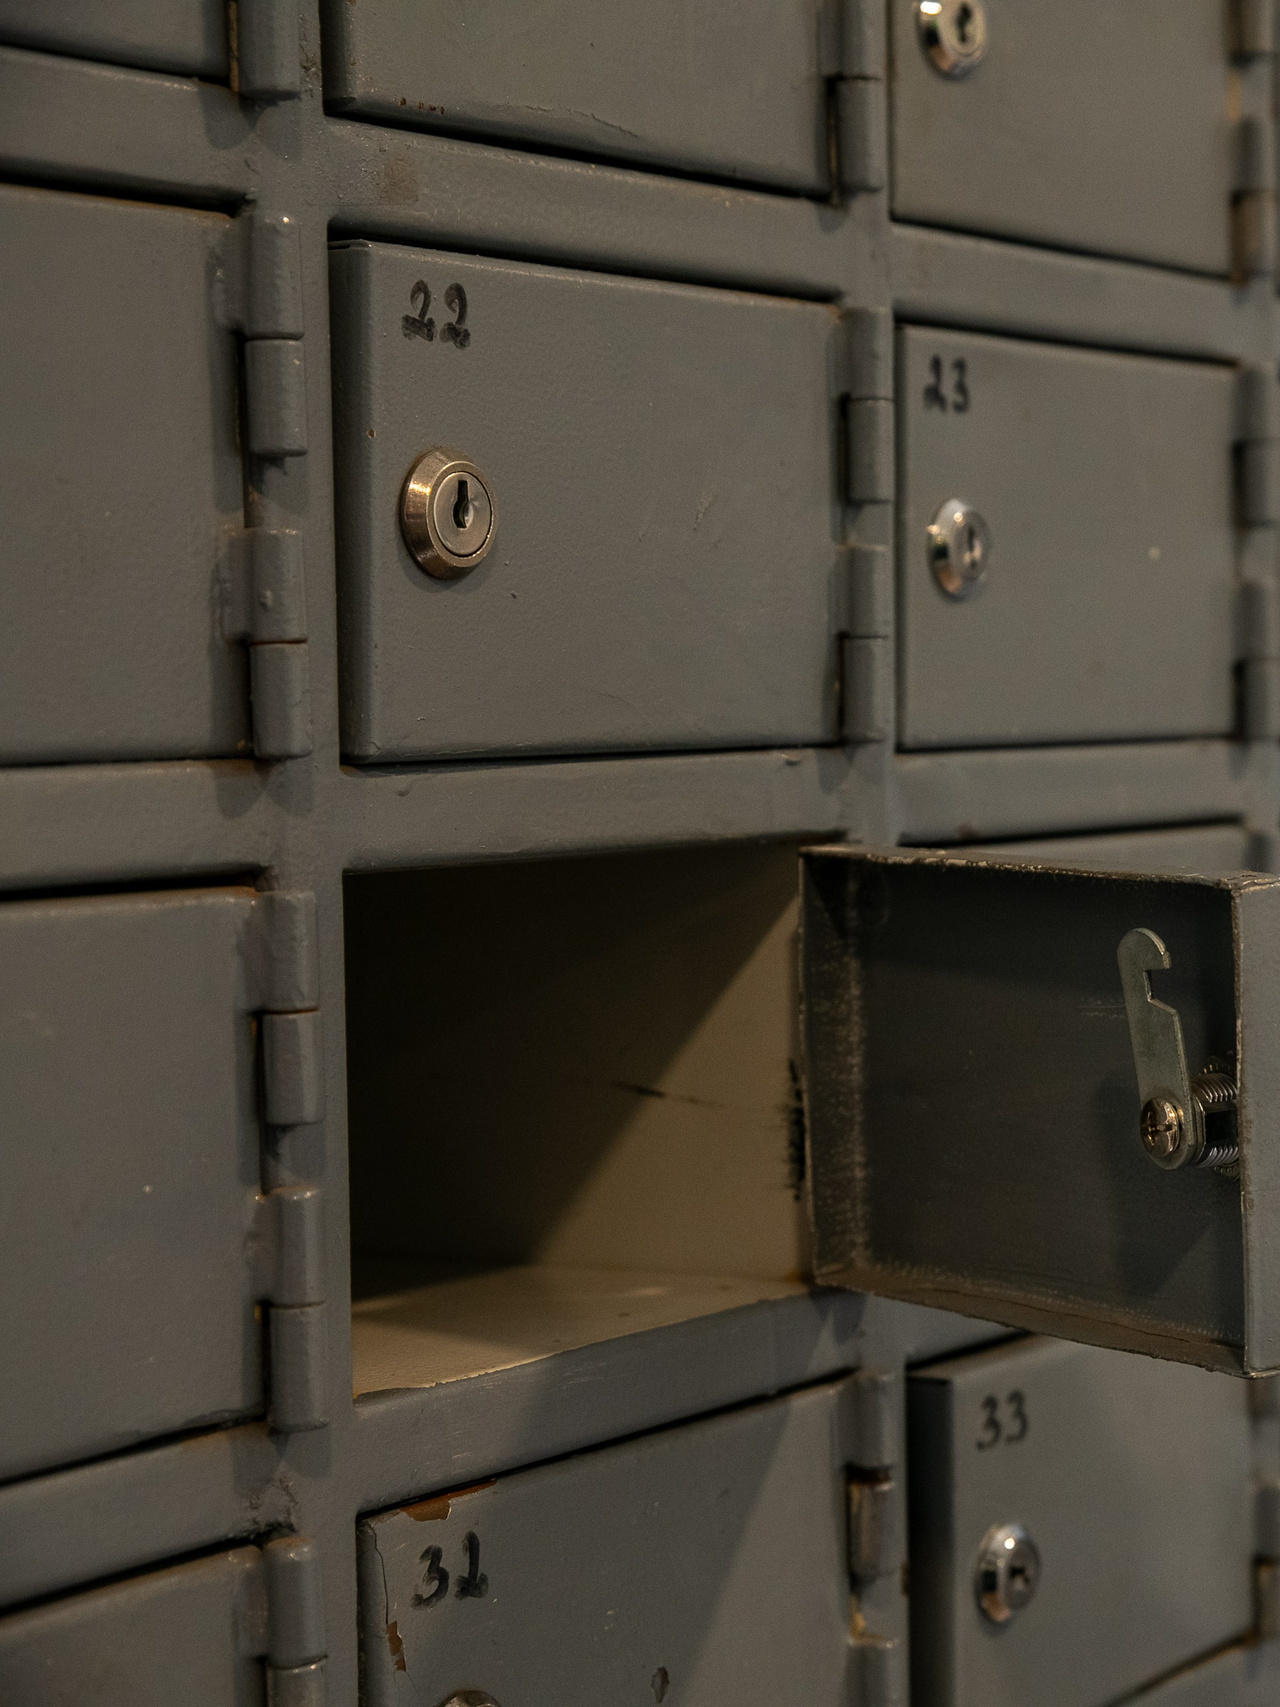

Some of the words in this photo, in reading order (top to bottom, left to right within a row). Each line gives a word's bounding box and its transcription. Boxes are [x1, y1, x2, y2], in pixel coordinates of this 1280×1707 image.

[402, 279, 471, 350] 22
[922, 353, 970, 414] 23
[975, 1388, 1029, 1451] 33
